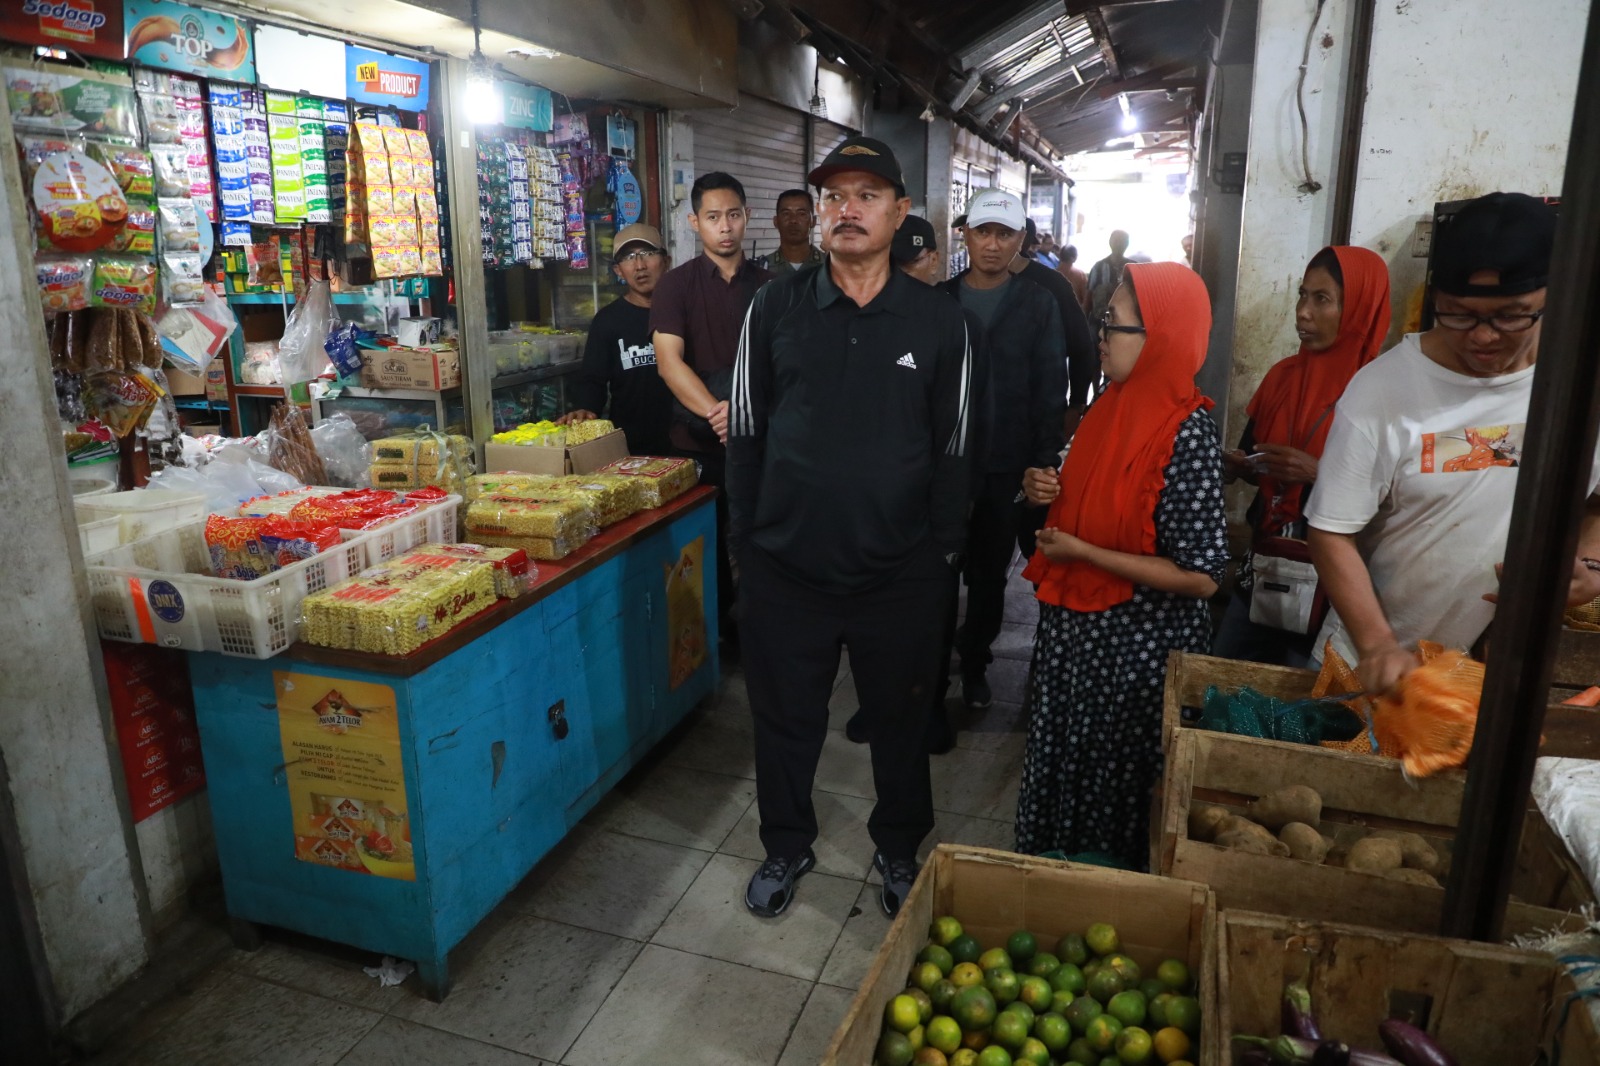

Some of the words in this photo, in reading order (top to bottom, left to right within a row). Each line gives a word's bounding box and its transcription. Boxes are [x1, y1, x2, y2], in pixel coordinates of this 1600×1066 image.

[23, 0, 106, 29] Sedaap
[171, 33, 213, 58] TOP
[360, 66, 376, 80] NEW
[380, 73, 417, 95] PRODUCT
[509, 96, 535, 118] ZINC
[896, 359, 916, 369] adidas
[248, 545, 259, 553] 12
[154, 593, 178, 608] DMX
[342, 715, 361, 726] TELOR
[141, 722, 158, 736] ABC
[292, 741, 313, 749] ALASAN
[314, 744, 333, 752] HARUS
[146, 752, 162, 766] ABC
[316, 766, 335, 774] UNTUK
[151, 782, 167, 795] ABC
